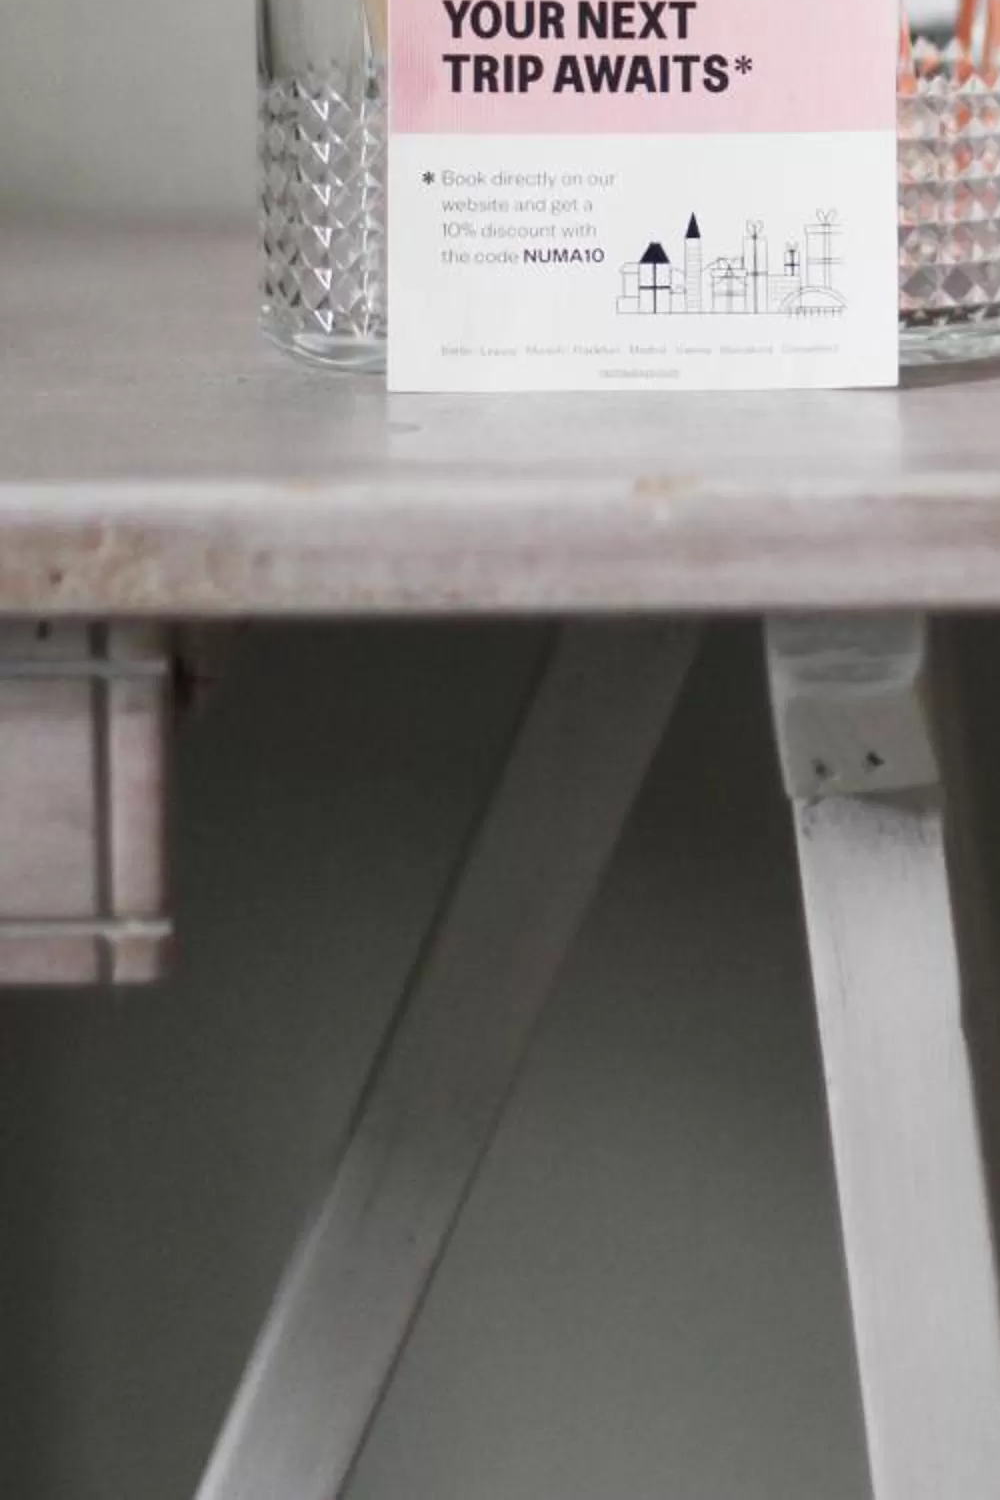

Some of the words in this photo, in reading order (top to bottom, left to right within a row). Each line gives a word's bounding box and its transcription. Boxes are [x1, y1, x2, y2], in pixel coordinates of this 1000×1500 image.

[442, 0, 565, 39] YOUR
[577, 0, 697, 39] NEXT
[442, 54, 544, 93] TRIP
[441, 170, 486, 187] Book
[490, 170, 557, 189] directly
[561, 173, 583, 187] on
[587, 173, 616, 187] our
[441, 197, 510, 213] website
[514, 197, 547, 213] and
[550, 199, 578, 216] get
[582, 201, 594, 213] a
[442, 221, 477, 238] 10%
[480, 222, 557, 238] discount
[560, 222, 598, 238] with
[441, 248, 470, 264] the
[474, 248, 520, 264] code
[523, 248, 605, 264] NUMA10
